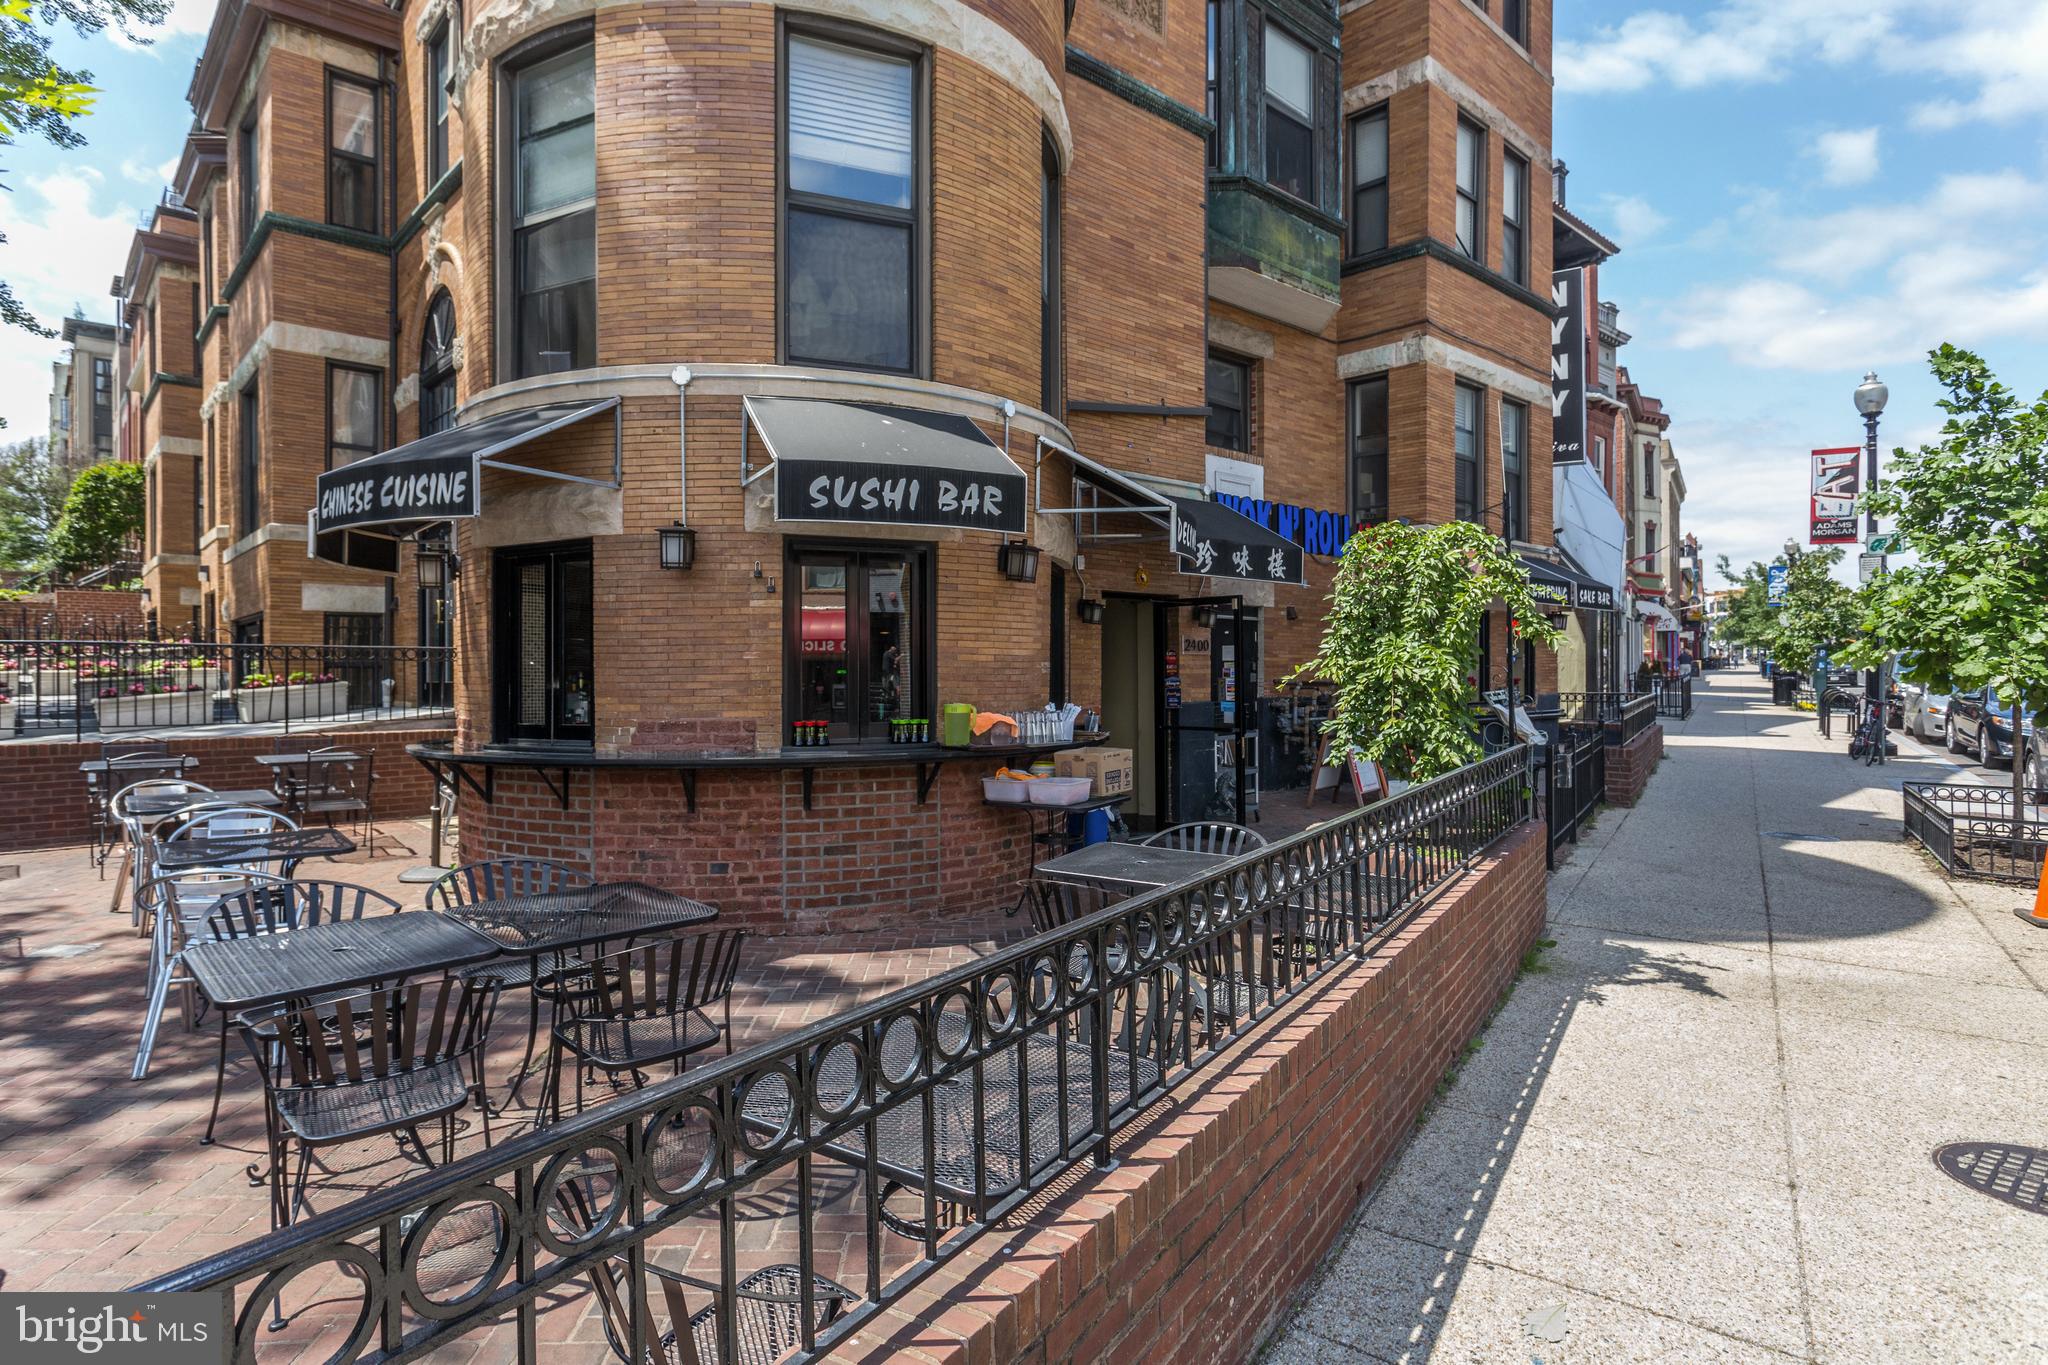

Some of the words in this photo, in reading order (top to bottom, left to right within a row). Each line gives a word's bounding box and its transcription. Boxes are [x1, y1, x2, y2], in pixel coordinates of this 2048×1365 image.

[322, 479, 374, 519] CHINESE
[380, 471, 468, 507] CUISINE
[809, 475, 920, 512] SUSHI
[938, 480, 1003, 516] BAR
[1812, 527, 1857, 537] MORGAN
[1816, 521, 1853, 531] ADAMS
[1579, 589, 1596, 604] SAKE
[1597, 591, 1611, 606] BAR
[1184, 639, 1209, 652] 2400
